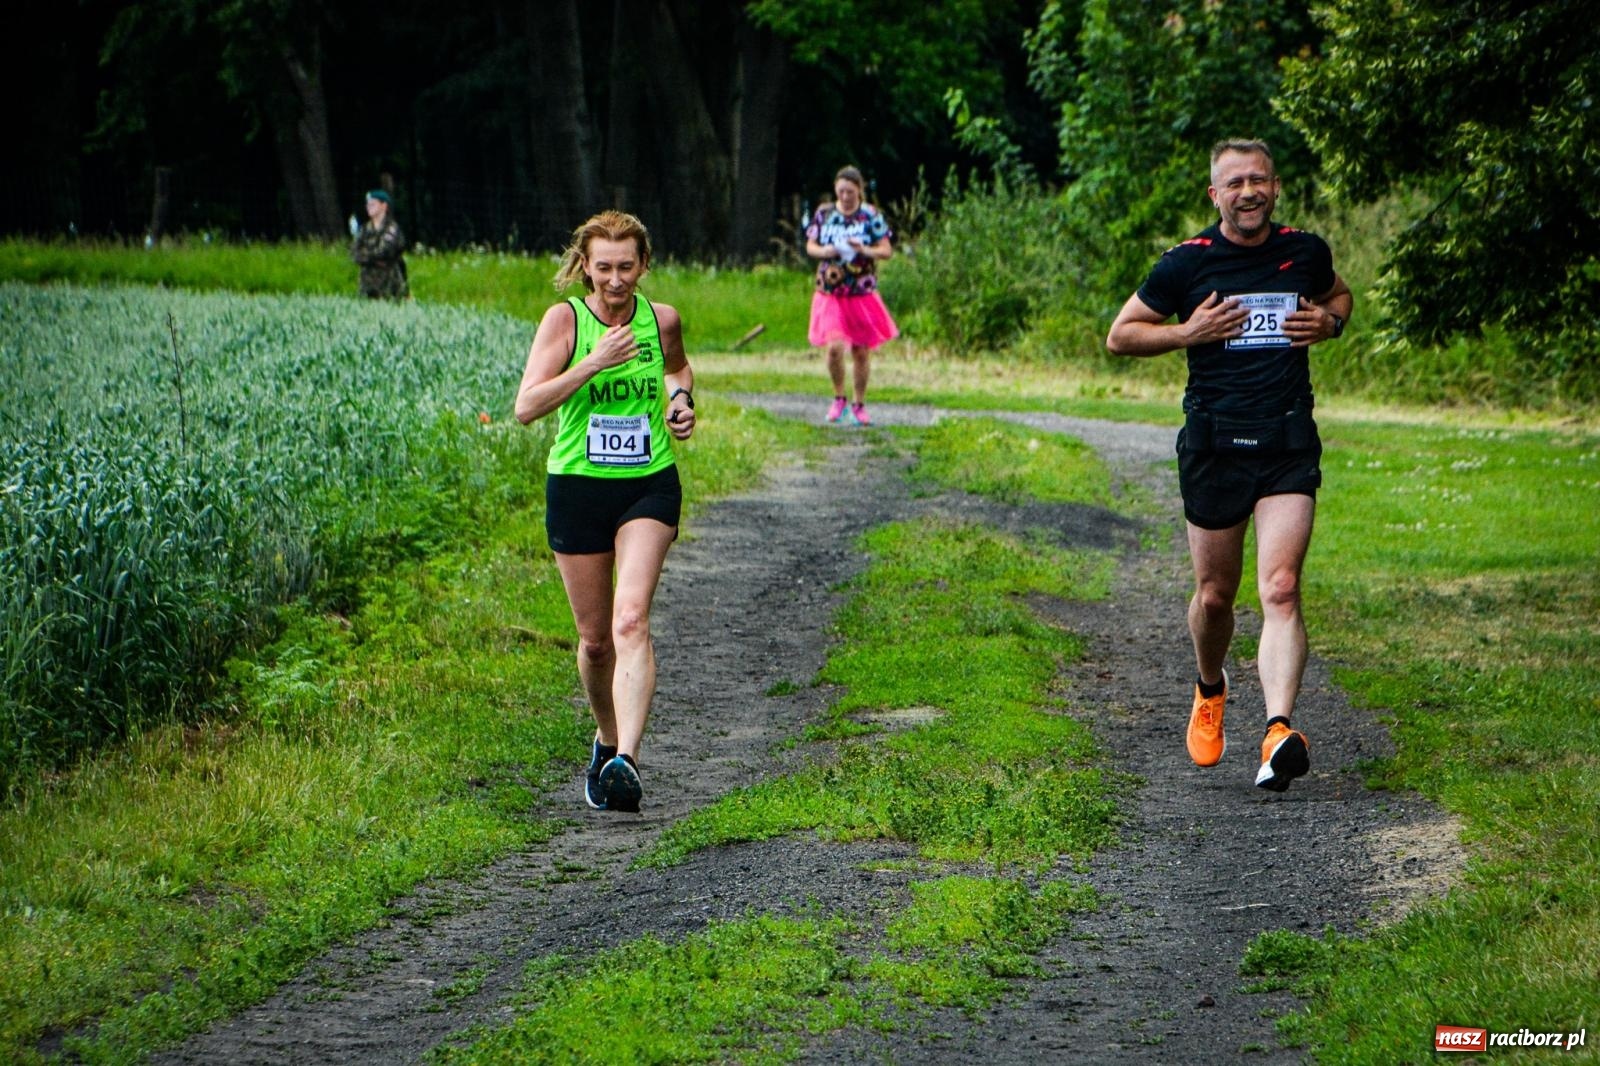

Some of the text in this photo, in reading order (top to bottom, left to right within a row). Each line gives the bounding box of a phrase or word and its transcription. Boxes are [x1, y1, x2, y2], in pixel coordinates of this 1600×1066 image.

[589, 378, 657, 404] MOVE
[601, 434, 636, 451] 104
[1233, 438, 1258, 446] KIPRUN
